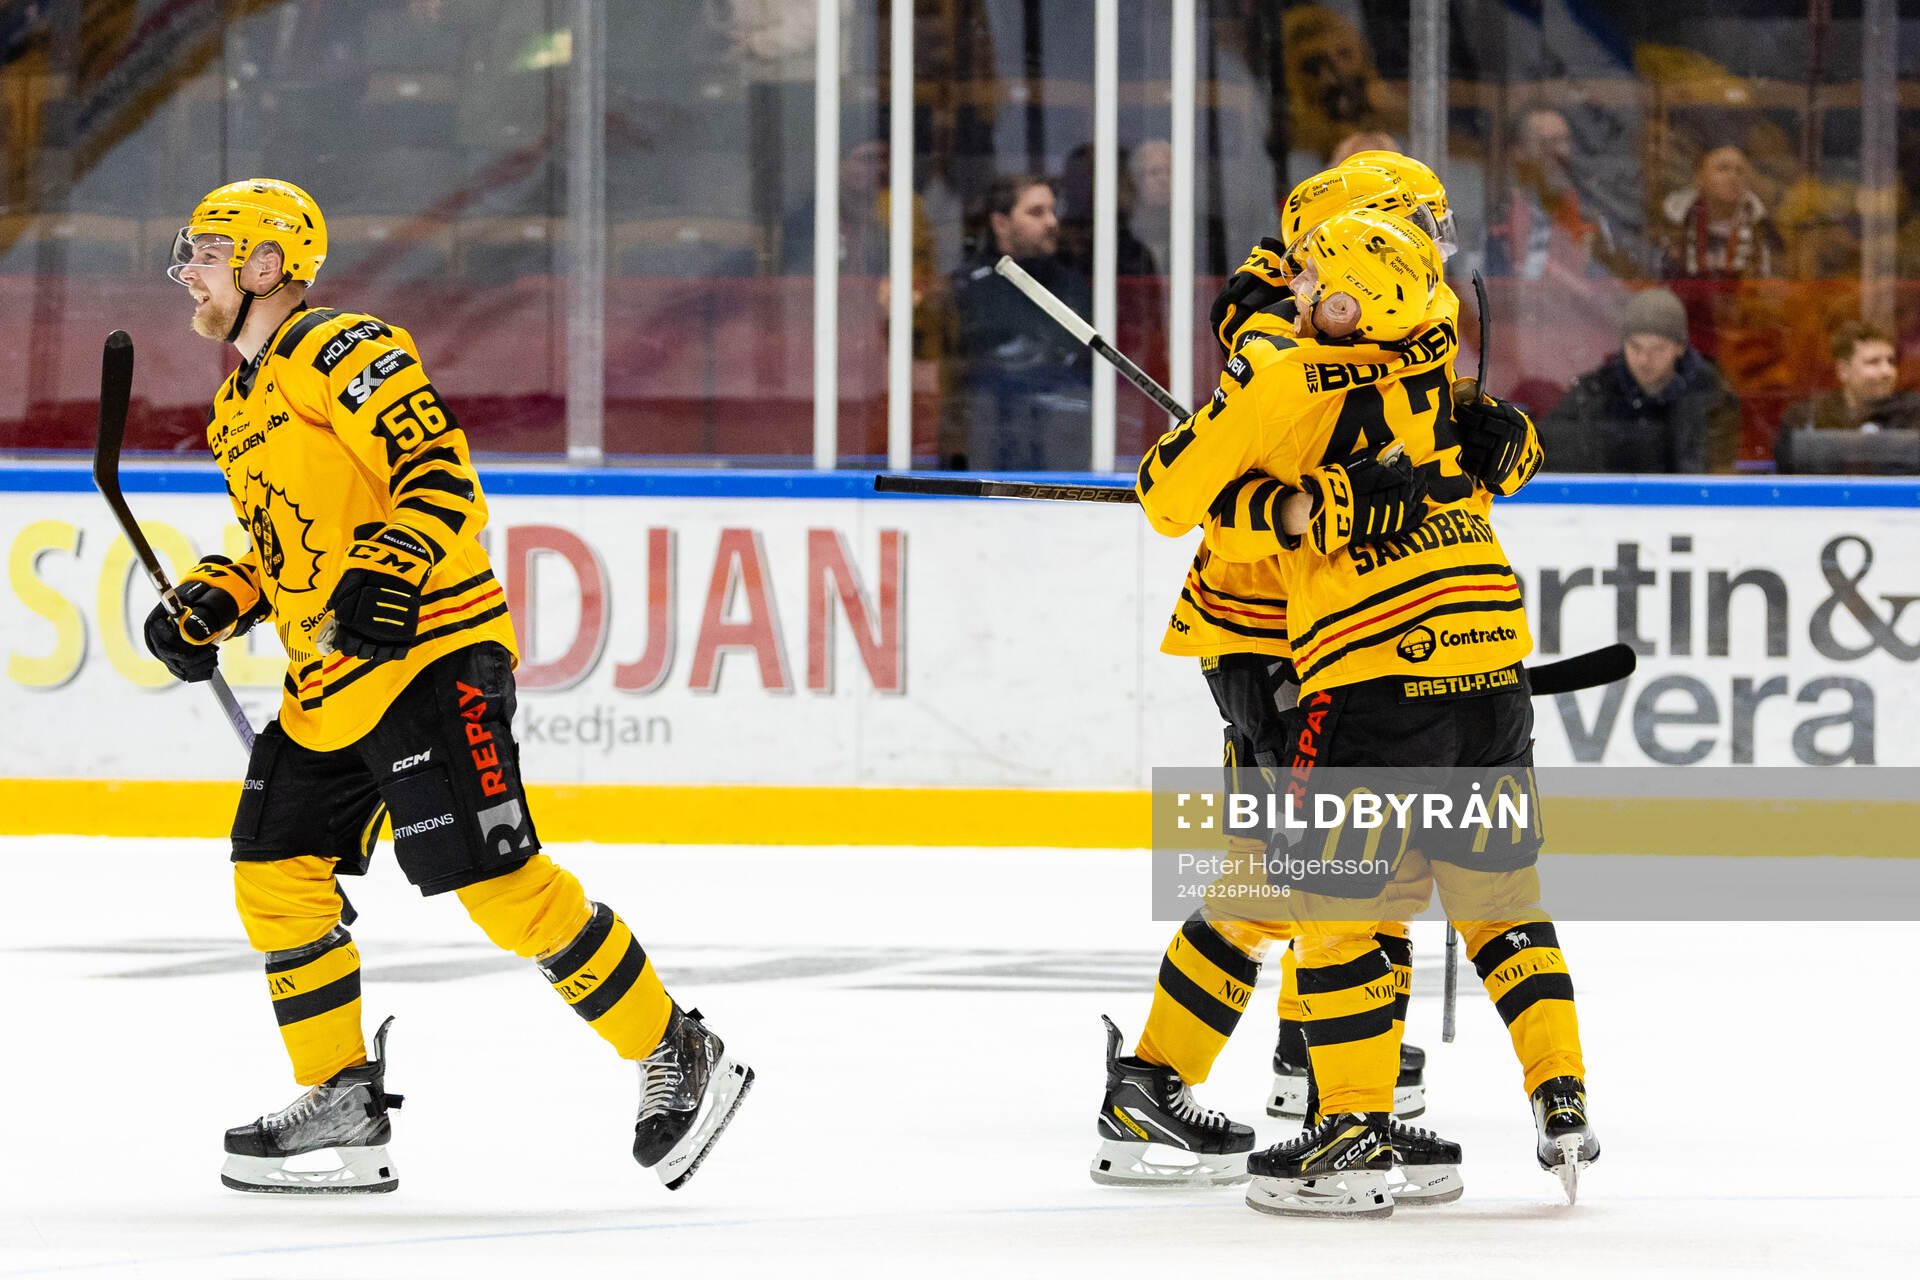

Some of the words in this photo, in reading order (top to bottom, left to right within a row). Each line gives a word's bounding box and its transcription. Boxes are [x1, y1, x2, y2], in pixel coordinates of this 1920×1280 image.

[1303, 362, 1319, 393] NEW
[381, 391, 447, 450] 56
[1404, 668, 1519, 698] BASTU-P.COM
[456, 680, 507, 797] REPAY
[392, 748, 432, 773] CCM
[1333, 1131, 1377, 1171] CCM
